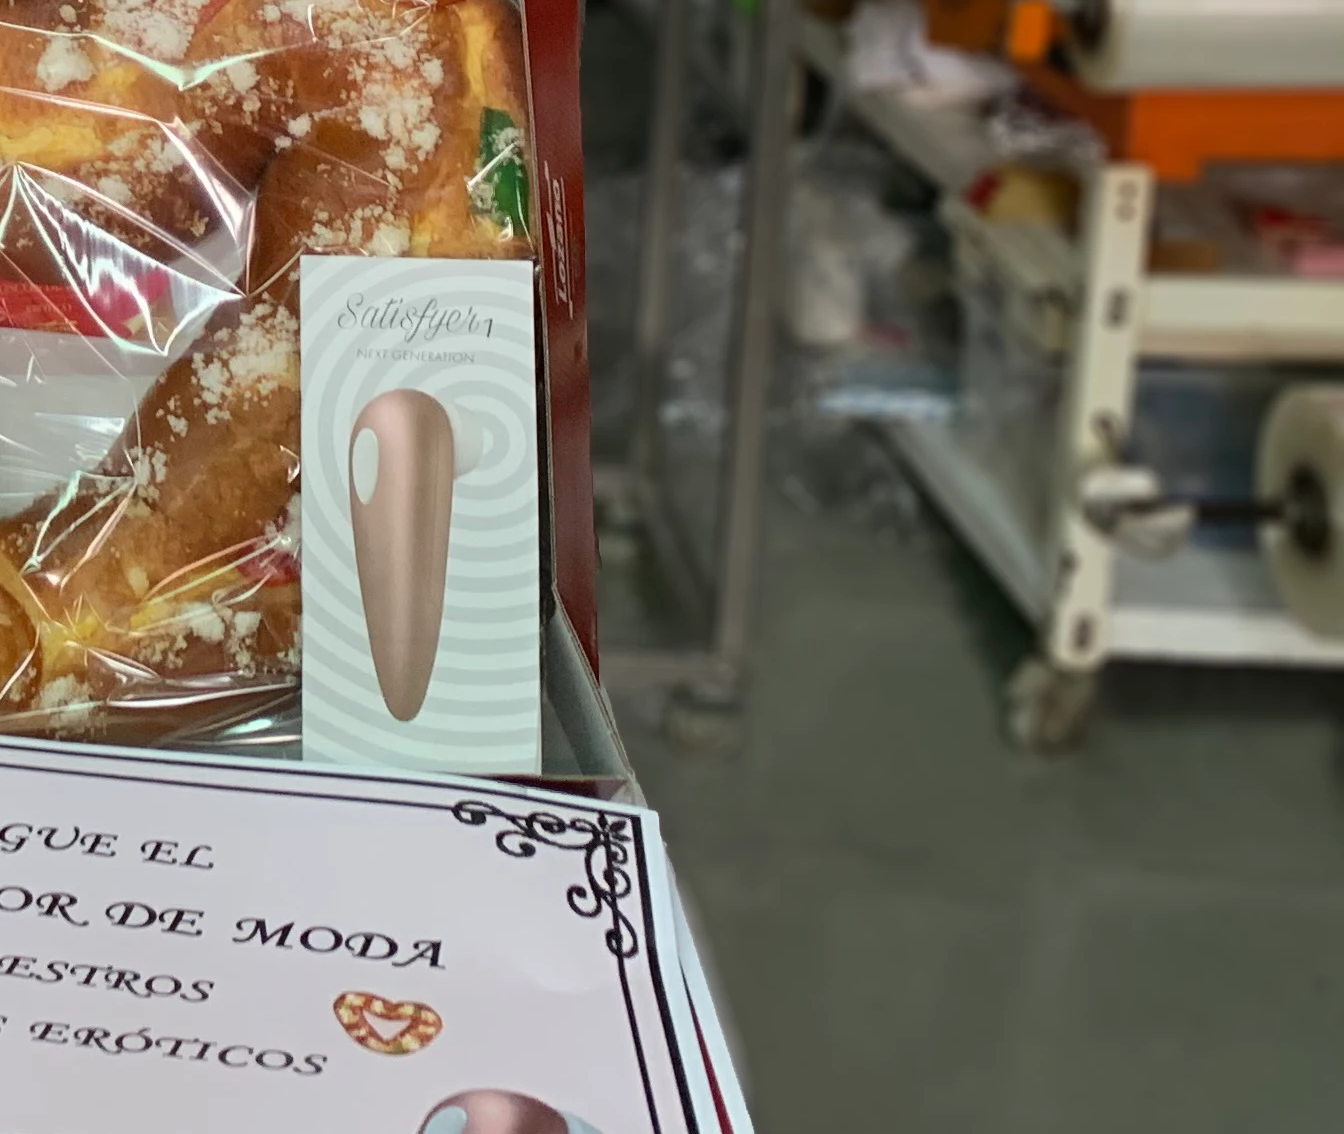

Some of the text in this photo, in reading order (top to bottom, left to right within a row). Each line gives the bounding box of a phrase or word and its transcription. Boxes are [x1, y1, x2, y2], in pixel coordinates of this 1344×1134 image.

[357, 348, 476, 364] NEXT GENERATION
[140, 838, 214, 869] EL
[105, 900, 204, 937] DE
[232, 916, 446, 969] MODA
[29, 1019, 328, 1076] ERÓTICOS
